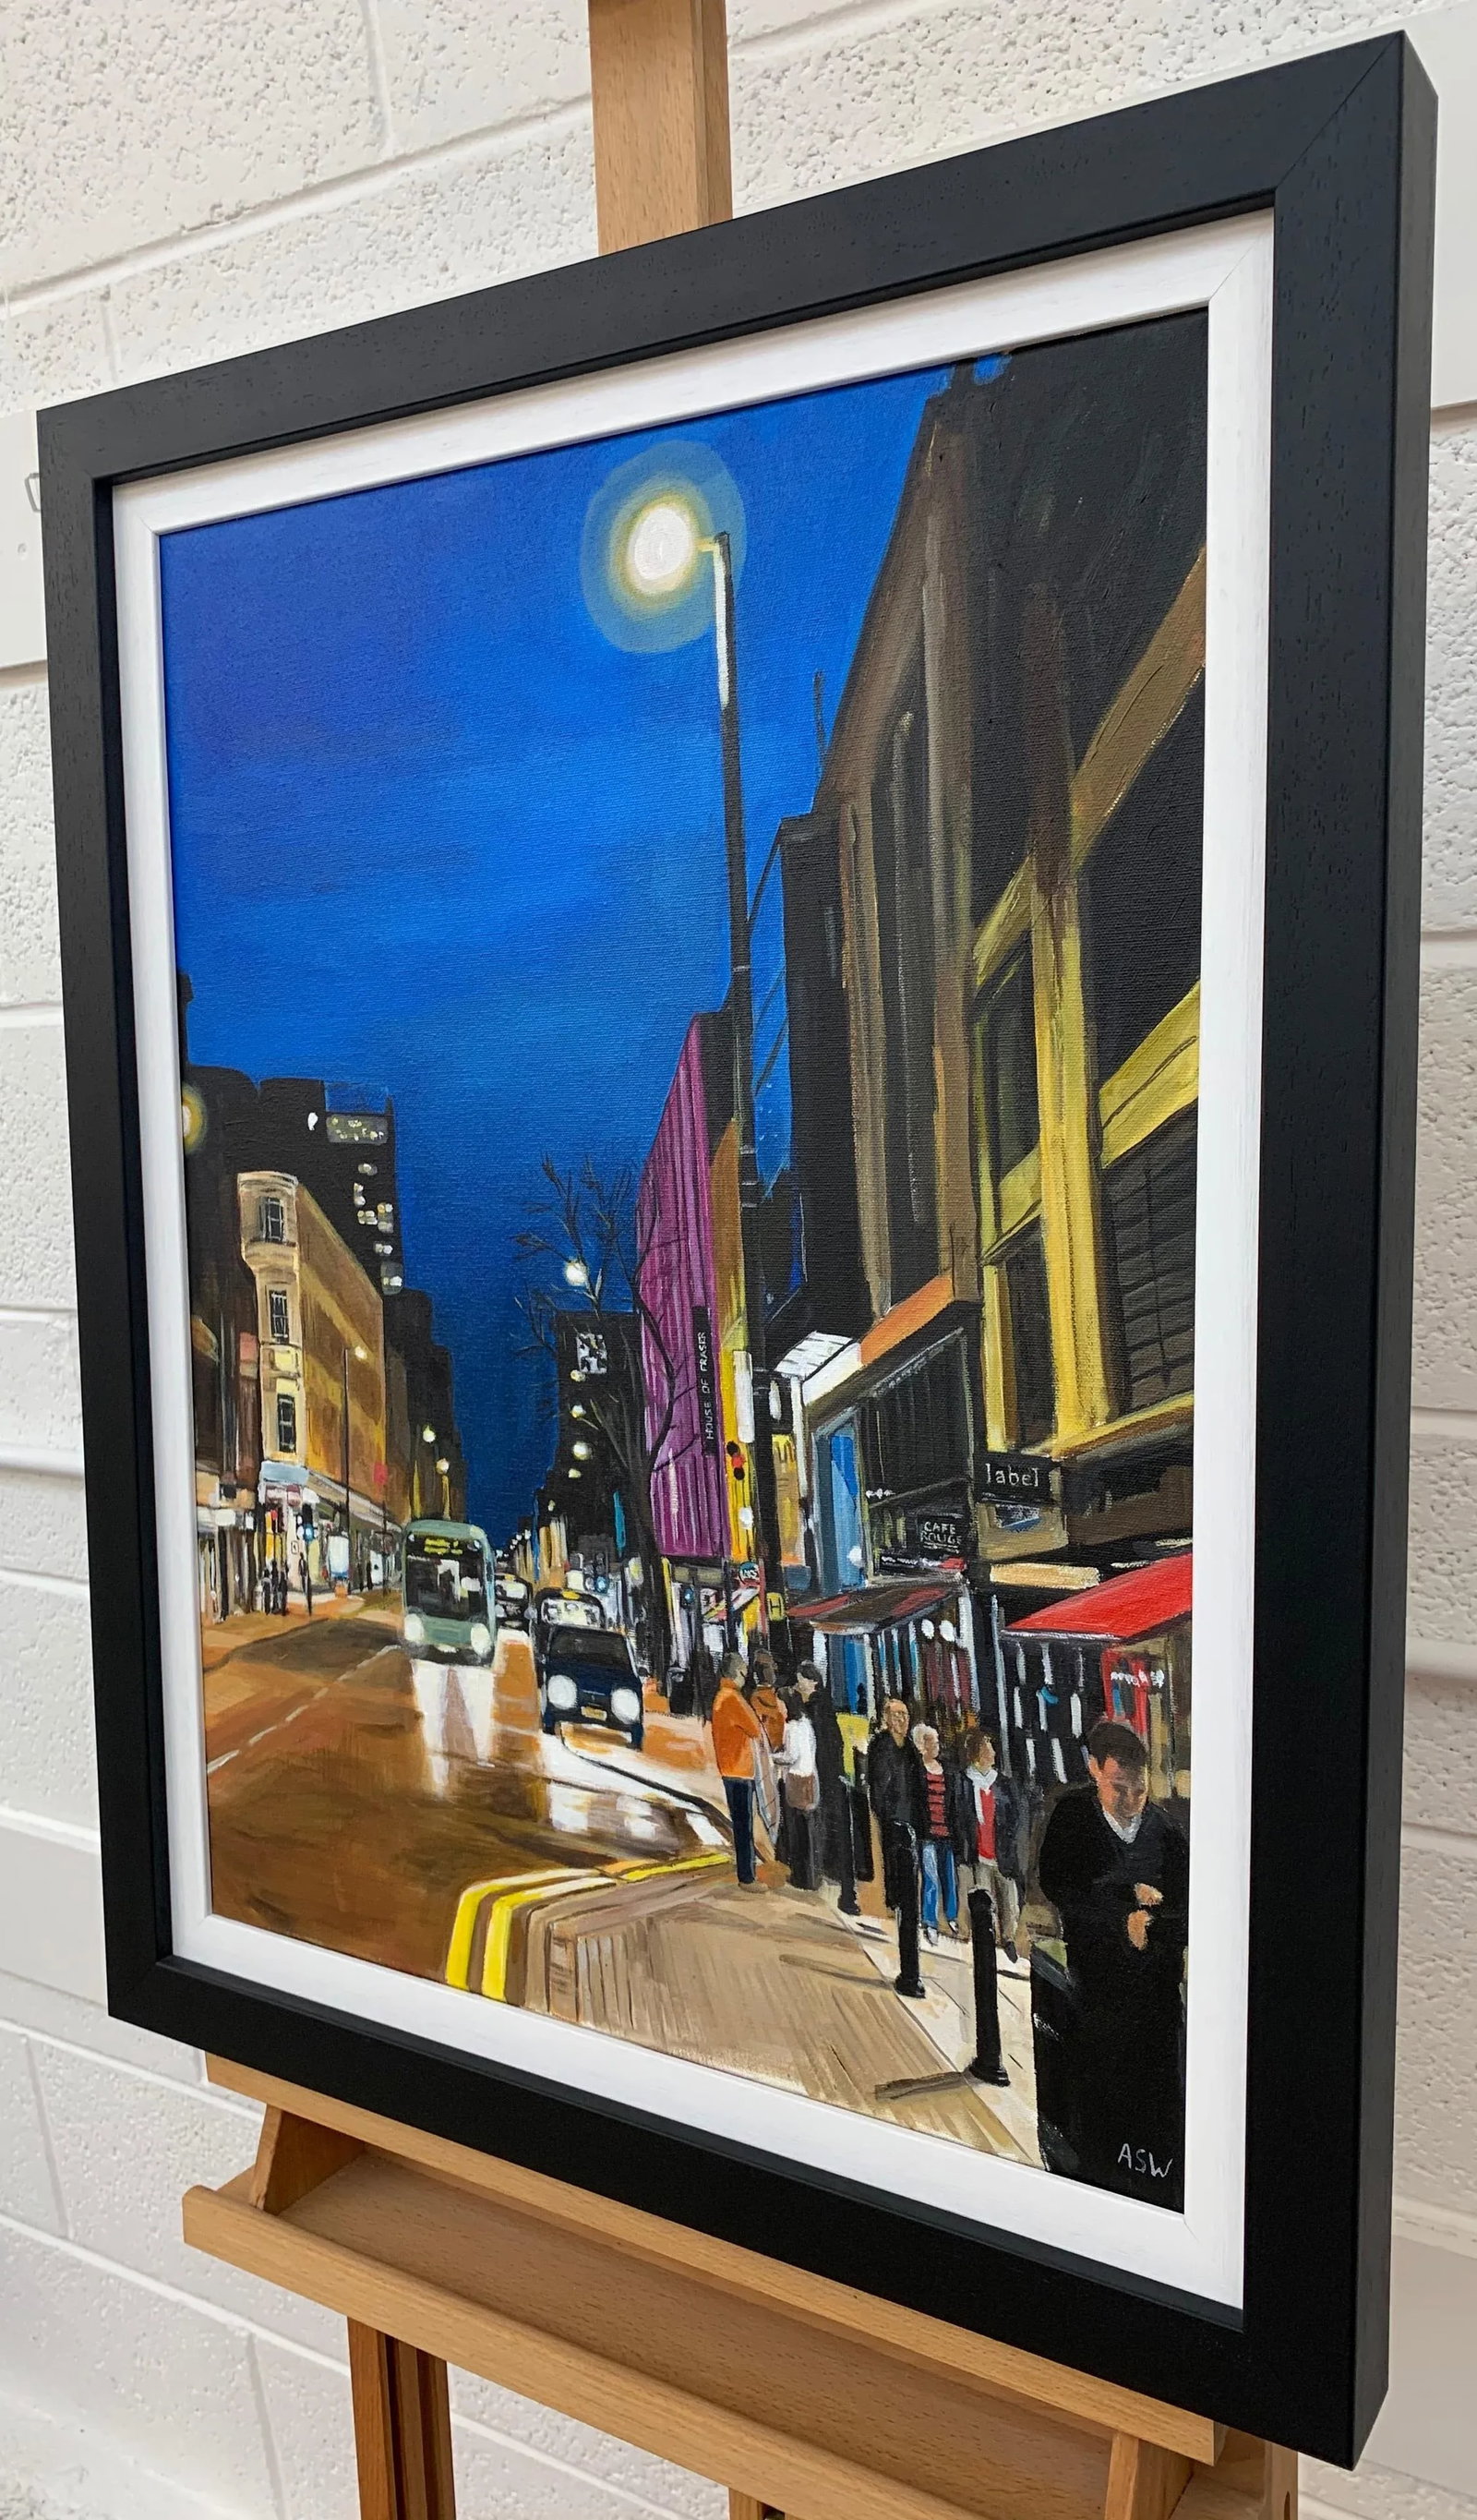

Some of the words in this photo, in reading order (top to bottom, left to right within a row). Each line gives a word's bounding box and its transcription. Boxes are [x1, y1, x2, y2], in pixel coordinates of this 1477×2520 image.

[697, 1332, 708, 1371] FRASER
[701, 1378, 710, 1393] OF
[704, 1402, 714, 1440] HOUSE
[985, 1462, 1039, 1488] label
[919, 1530, 962, 1546] ROUGE
[924, 1521, 956, 1536] CAFE
[1117, 2142, 1173, 2178] ASW
